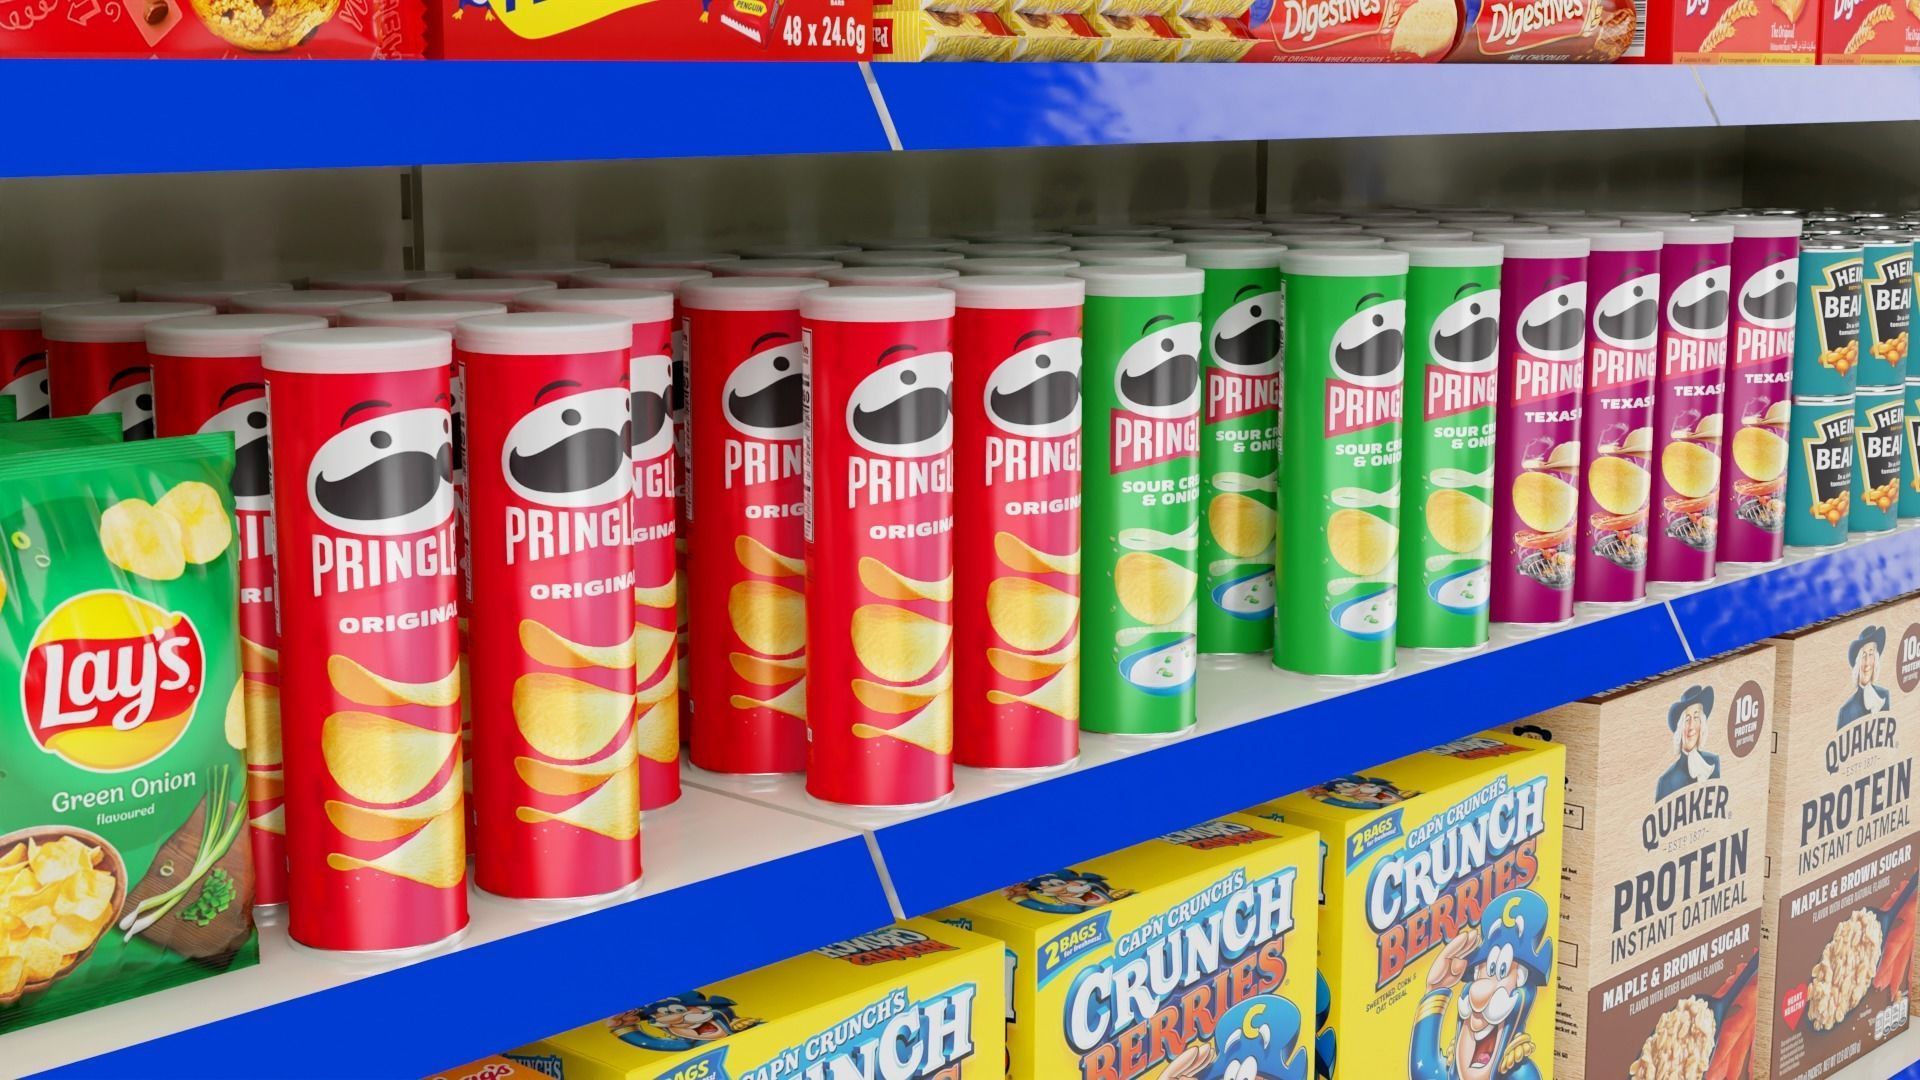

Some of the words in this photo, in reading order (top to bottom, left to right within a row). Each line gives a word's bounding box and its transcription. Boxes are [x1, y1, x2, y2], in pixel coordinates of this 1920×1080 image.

[735, 0, 764, 13] PENGUIN
[1282, 0, 1381, 42] Digestives
[1486, 0, 1584, 45] Digestives
[783, 15, 802, 46] 48
[807, 23, 817, 46] x
[822, 16, 866, 54] 24.6g
[1428, 370, 1497, 415] PRING
[1516, 357, 1584, 400] PRING
[1216, 429, 1261, 441] SOUR
[1233, 442, 1246, 453] &
[1335, 443, 1382, 455] SOUR
[1433, 426, 1478, 438] SOUR
[1451, 438, 1464, 449] &
[848, 448, 953, 509] PRINGL
[1353, 456, 1367, 467] &
[1122, 480, 1175, 494] SOUR
[1142, 494, 1157, 506] &
[505, 496, 635, 566] PRINGL
[40, 627, 191, 730] Lay's
[1734, 722, 1757, 738] PROTEIN
[1826, 717, 1897, 775] QUAKER
[52, 785, 125, 813] Green
[131, 771, 196, 800] Onion
[96, 803, 156, 825] flavoured
[1408, 814, 1445, 848] CAP'N
[1446, 777, 1507, 825] CRUNCH'S
[1800, 757, 1912, 848] PROTEIN
[1353, 833, 1364, 857] 2
[1363, 817, 1393, 843] BAGS
[1642, 785, 1729, 853] QUAKER
[1799, 831, 1853, 876] INSTANT
[1856, 804, 1910, 848] OATMEAL
[1366, 838, 1374, 847] for
[1371, 779, 1548, 932] CRUNCH
[1612, 828, 1749, 933] PROTEIN
[1791, 884, 1829, 919] MAPLE
[1830, 879, 1838, 898] &
[1840, 860, 1878, 894] BROWN
[1879, 844, 1912, 875] SUGAR
[1118, 915, 1165, 957] CAP'N
[1167, 870, 1244, 927] CRUNCH'S
[1375, 838, 1538, 992] BERRIES
[1611, 912, 1677, 964] INSTANT
[1682, 880, 1748, 930] OATMEAL
[1045, 941, 1060, 970] 2
[1060, 922, 1097, 948] BAGS
[1064, 946, 1073, 959] for
[1073, 933, 1102, 954] freshness!
[1070, 869, 1297, 1052] CRUNCH
[1602, 972, 1649, 1012] MAPLE
[1651, 967, 1661, 987] &
[1664, 943, 1709, 982] BROWN
[1711, 923, 1750, 958] SUGAR
[1082, 940, 1287, 1080] BERRIES
[1366, 987, 1396, 1012] SWEETENED
[1397, 975, 1411, 991] CORN
[1376, 1002, 1387, 1014] OAT
[1389, 990, 1407, 1006] CEREAL
[1629, 997, 1649, 1016] FLAVOR
[1650, 990, 1663, 1004] WITH
[1664, 982, 1680, 998] OTHER
[1681, 973, 1703, 989] NATURAL
[1703, 959, 1724, 978] FLAVORS
[805, 988, 907, 1060] CRUNCH'S
